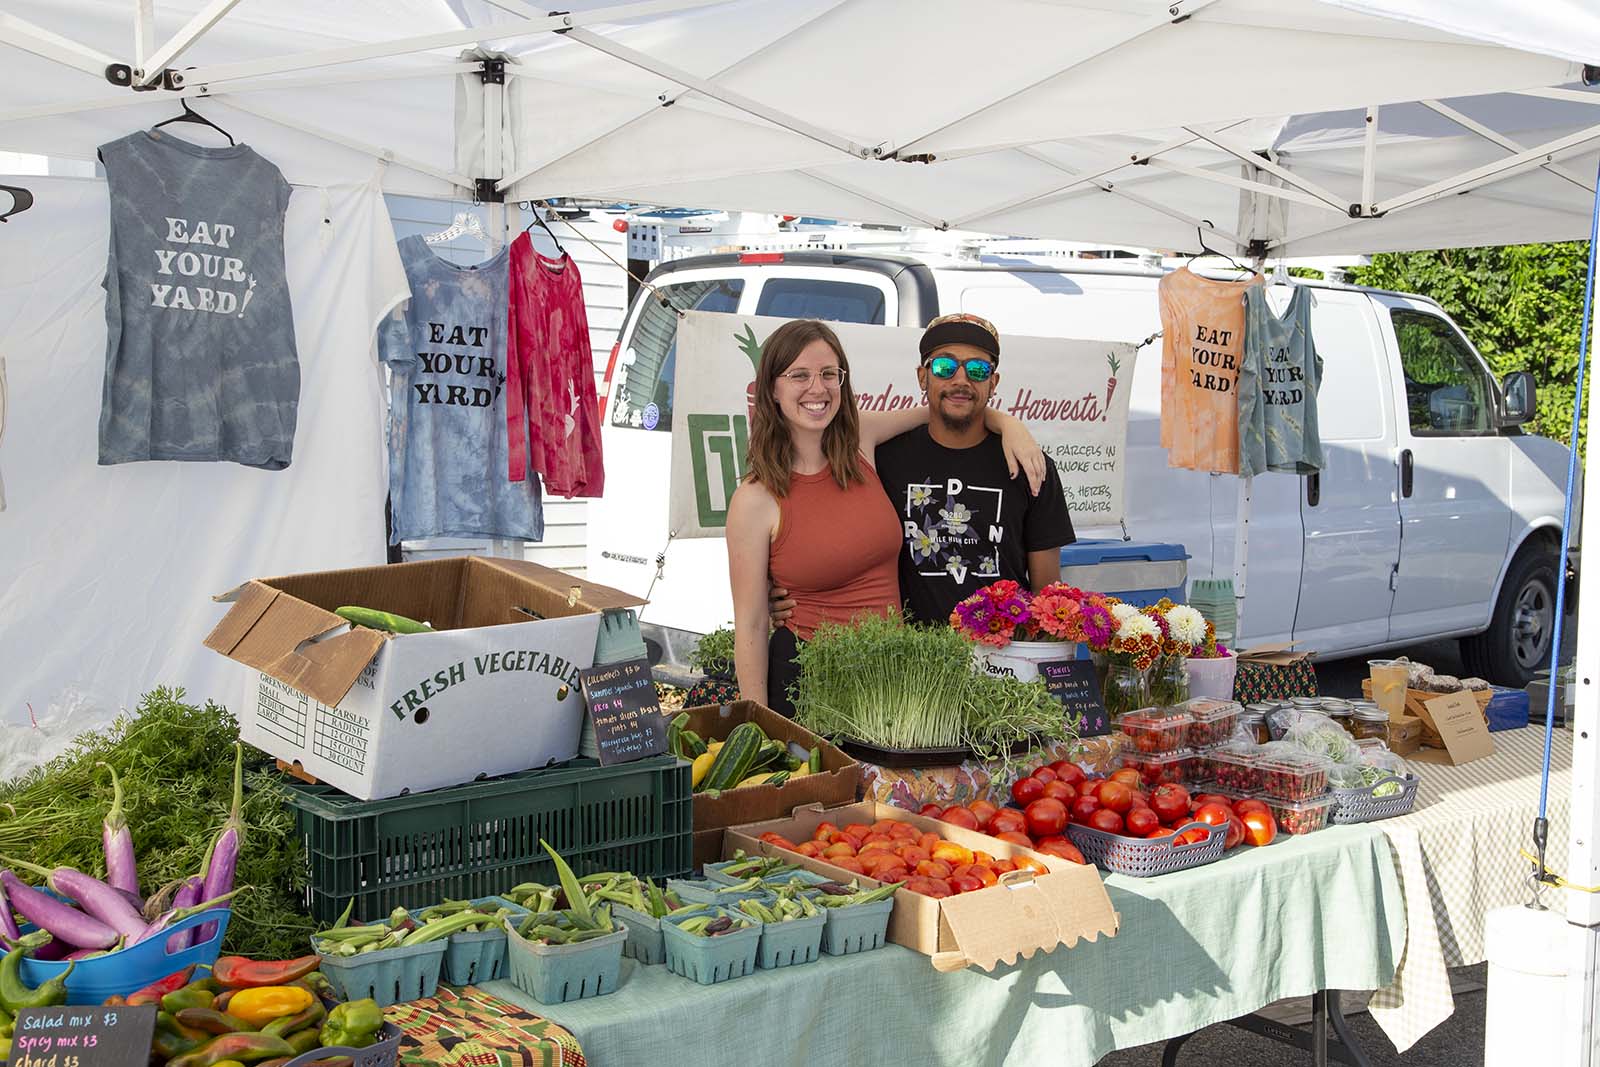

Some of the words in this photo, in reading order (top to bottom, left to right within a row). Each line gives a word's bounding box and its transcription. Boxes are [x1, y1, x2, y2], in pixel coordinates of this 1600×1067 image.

[165, 217, 235, 248] EAT
[154, 250, 246, 282] YOUR
[428, 322, 488, 347] EAT
[1195, 325, 1232, 346] EAT
[417, 352, 496, 378] YOUR
[1191, 346, 1236, 370] YOUR
[1007, 374, 1117, 422] Harvests!
[1056, 444, 1102, 457] PARCELS
[1105, 445, 1116, 457] IN
[1093, 461, 1116, 472] CITY
[947, 478, 963, 496] D
[1078, 484, 1112, 500] HERBS,
[904, 521, 918, 538] R
[988, 525, 1004, 543] N
[950, 566, 968, 584] V
[259, 683, 280, 700] SMALL
[390, 661, 466, 721] FRESH
[257, 704, 280, 722] LARGE
[258, 693, 285, 714] MEDIUM
[331, 717, 363, 737] RADISH
[333, 708, 370, 727] PARSLEY
[331, 729, 338, 739] 12
[339, 732, 367, 750] COUNT
[338, 743, 366, 761] COUNT
[336, 754, 364, 773] COUNT
[23, 1014, 64, 1030] Salad
[69, 1015, 93, 1027] mix
[103, 1012, 118, 1027] $3
[18, 1035, 52, 1054] Spicy
[57, 1036, 78, 1047] mix
[83, 1035, 98, 1048] $3
[63, 1056, 80, 1067] $3
